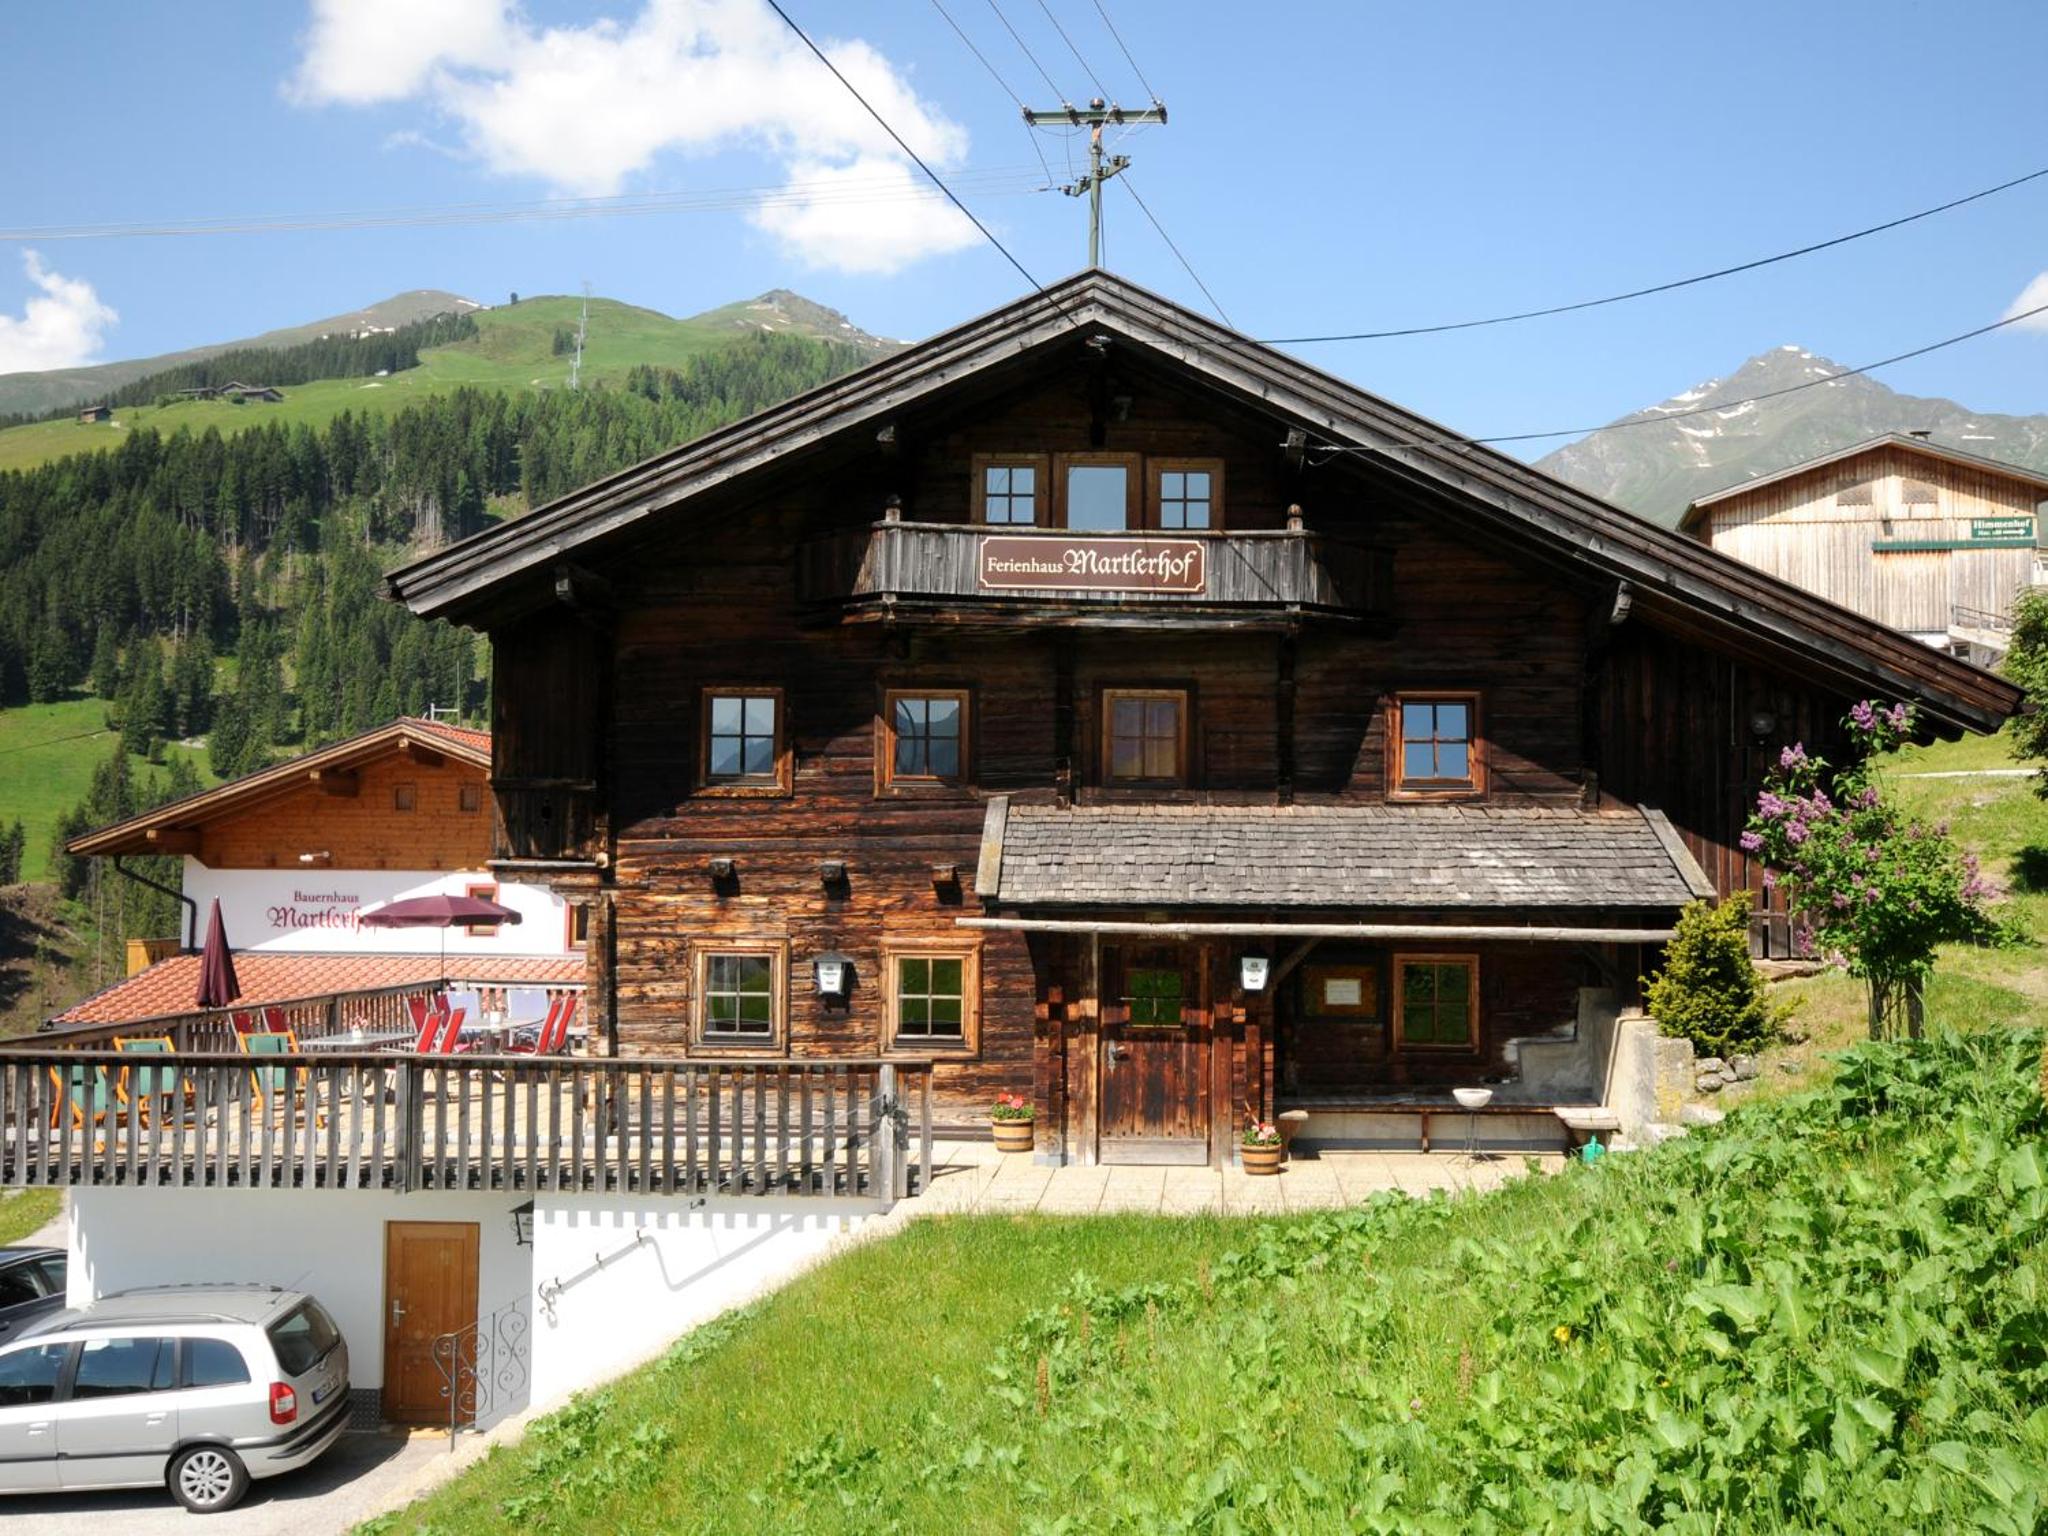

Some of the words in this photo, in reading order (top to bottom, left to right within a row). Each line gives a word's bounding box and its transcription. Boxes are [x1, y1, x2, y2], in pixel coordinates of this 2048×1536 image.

[987, 556, 1064, 574] Ferienhaus
[1063, 549, 1197, 583] Martlerhof
[294, 890, 359, 902] Bauernhaus
[266, 905, 376, 936] Martlerh
